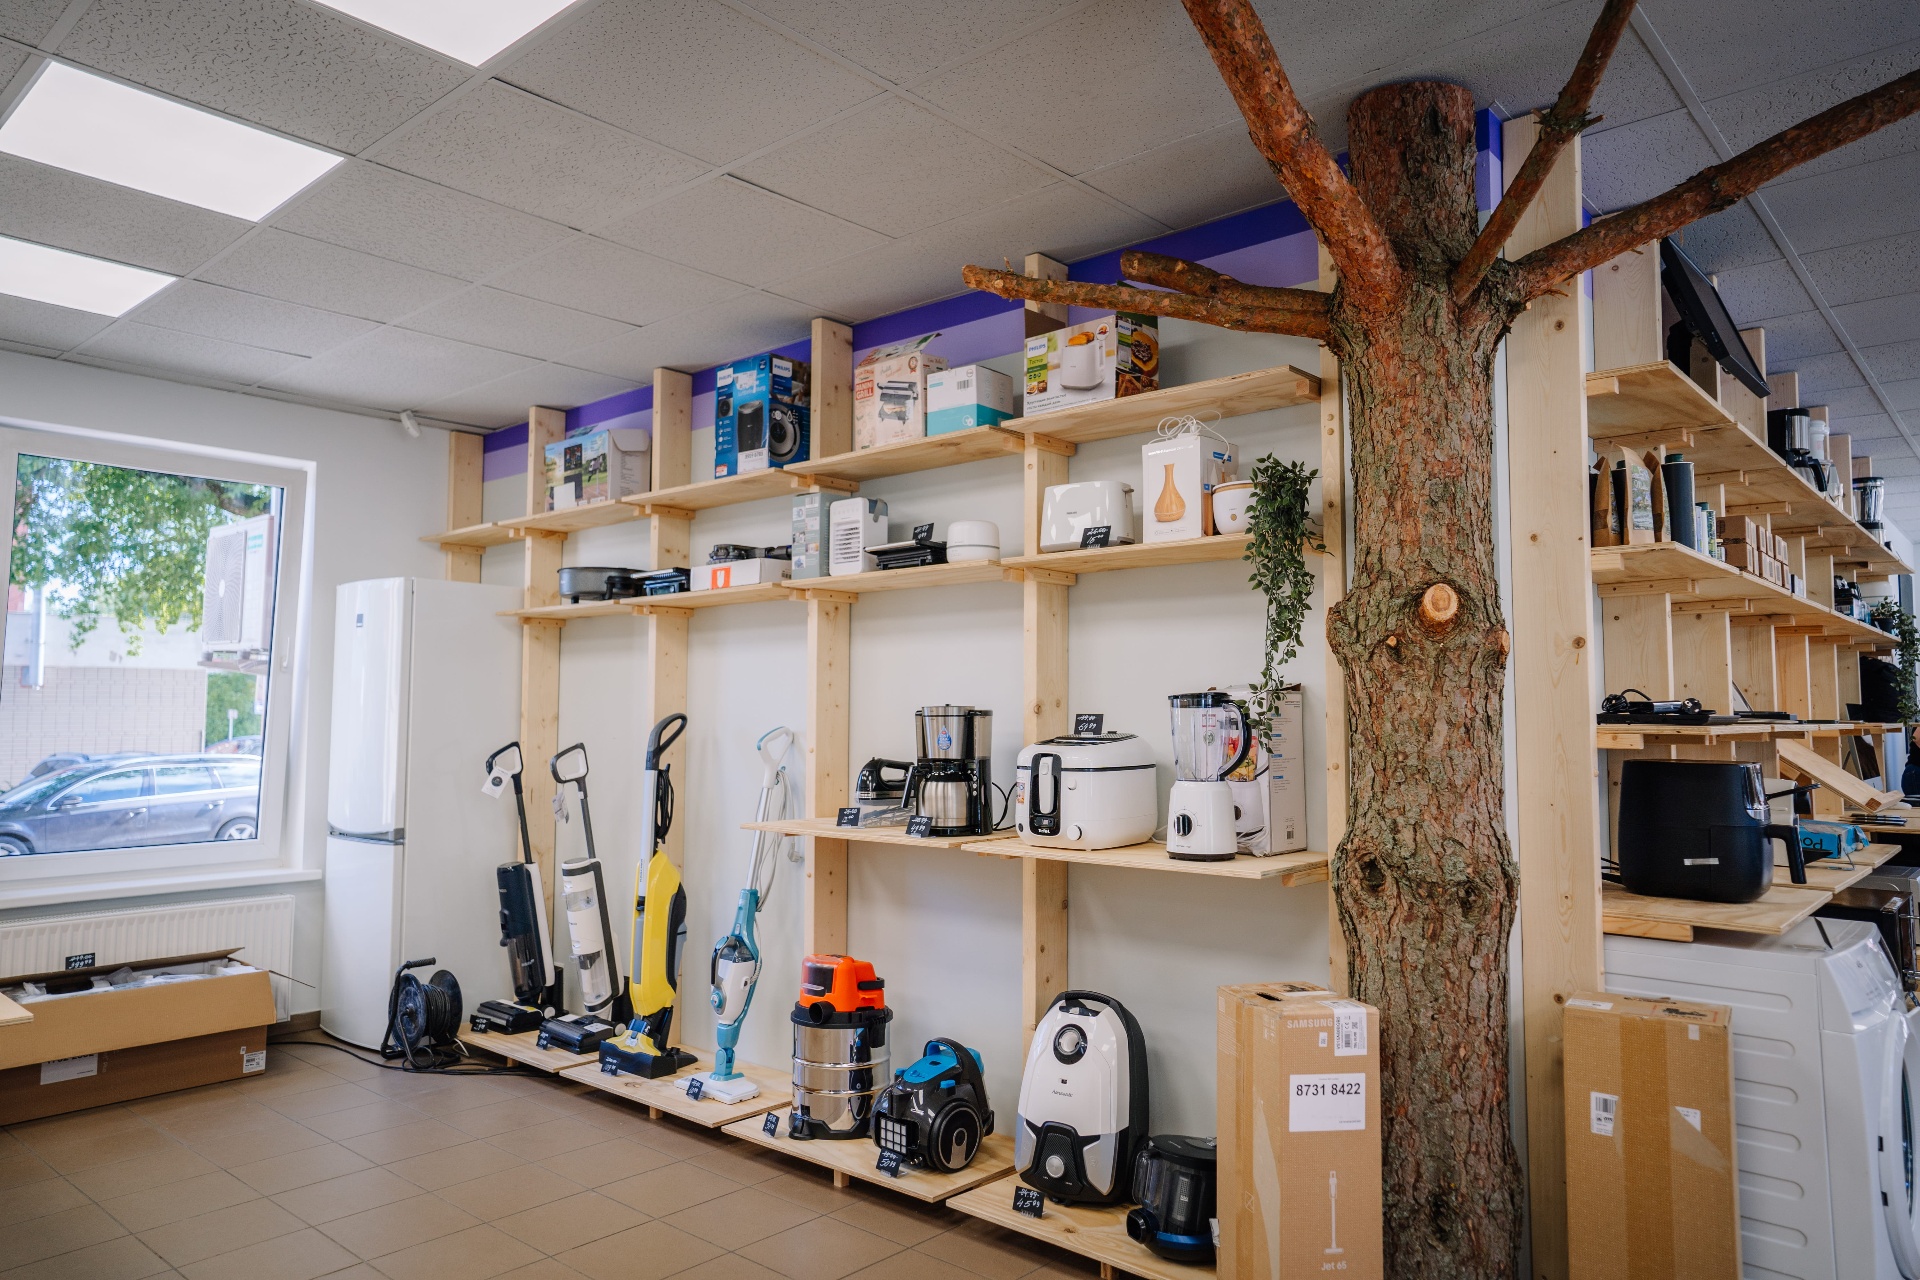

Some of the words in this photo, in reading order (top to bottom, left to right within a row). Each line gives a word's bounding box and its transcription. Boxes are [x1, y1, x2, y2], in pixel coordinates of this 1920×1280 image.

[1028, 343, 1047, 352] PHILIPS
[774, 363, 791, 373] PHILIPS
[856, 389, 874, 399] GRILL
[1287, 1018, 1333, 1029] SAMSUNG
[1296, 1084, 1326, 1097] 8731
[1331, 1083, 1361, 1096] 8422
[1321, 1261, 1335, 1271] Jet
[1336, 1260, 1347, 1270] 65
